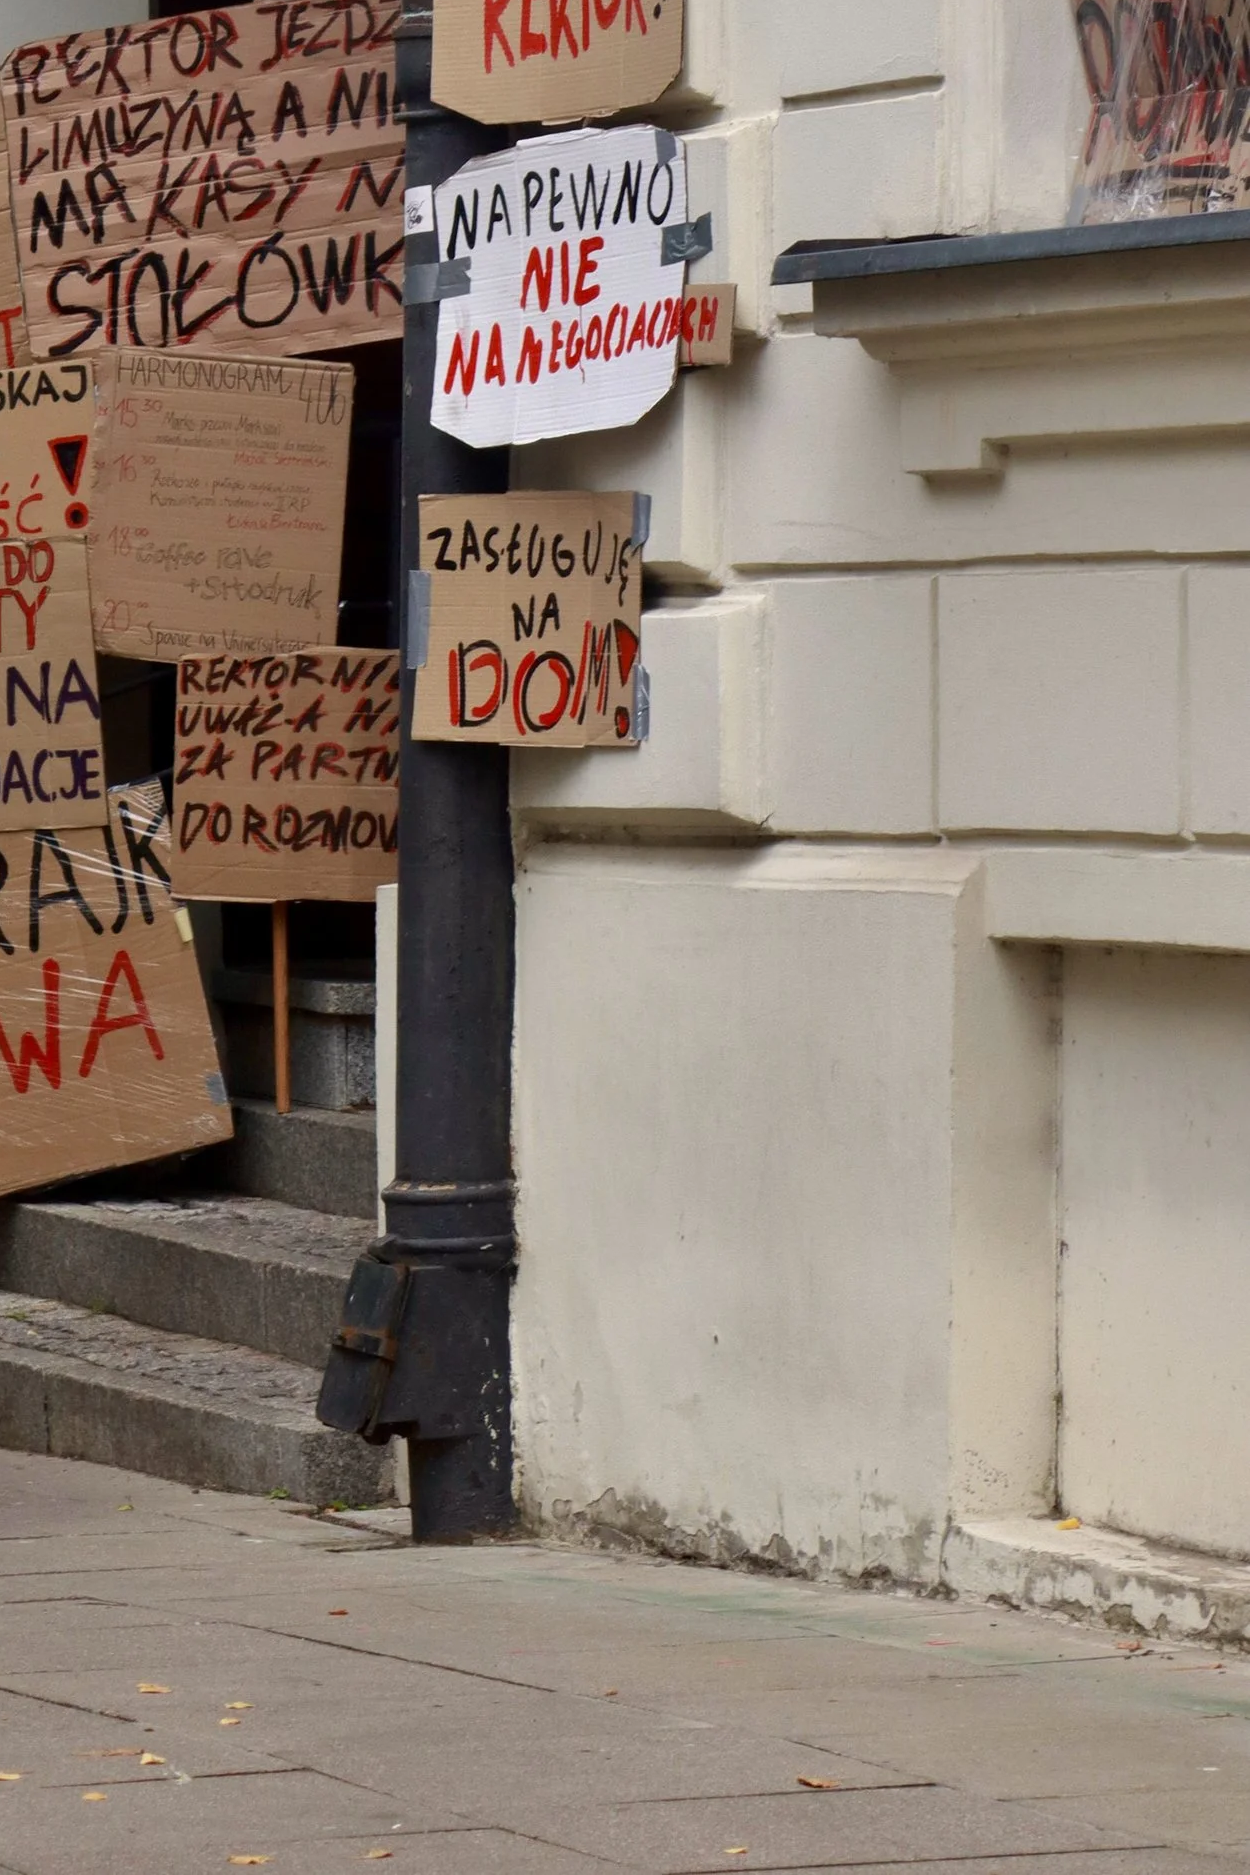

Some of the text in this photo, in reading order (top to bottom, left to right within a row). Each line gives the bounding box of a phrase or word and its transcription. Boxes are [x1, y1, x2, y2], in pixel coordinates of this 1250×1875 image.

[12, 11, 243, 116] REKTOR
[19, 66, 403, 186] LIMUZYNĄ A NI
[30, 147, 405, 254] MA KASY N
[520, 235, 605, 314] NIE
[117, 354, 293, 395] HARMONOGRAM
[3, 540, 56, 587] DO
[426, 519, 634, 608] ZASŁUGUJĘ
[511, 591, 561, 642] NA
[6, 658, 101, 727] NA
[179, 654, 325, 695] REKTOR
[177, 691, 328, 737] UWAŻA
[176, 737, 400, 788] ZA PARTN
[179, 802, 233, 854] DO
